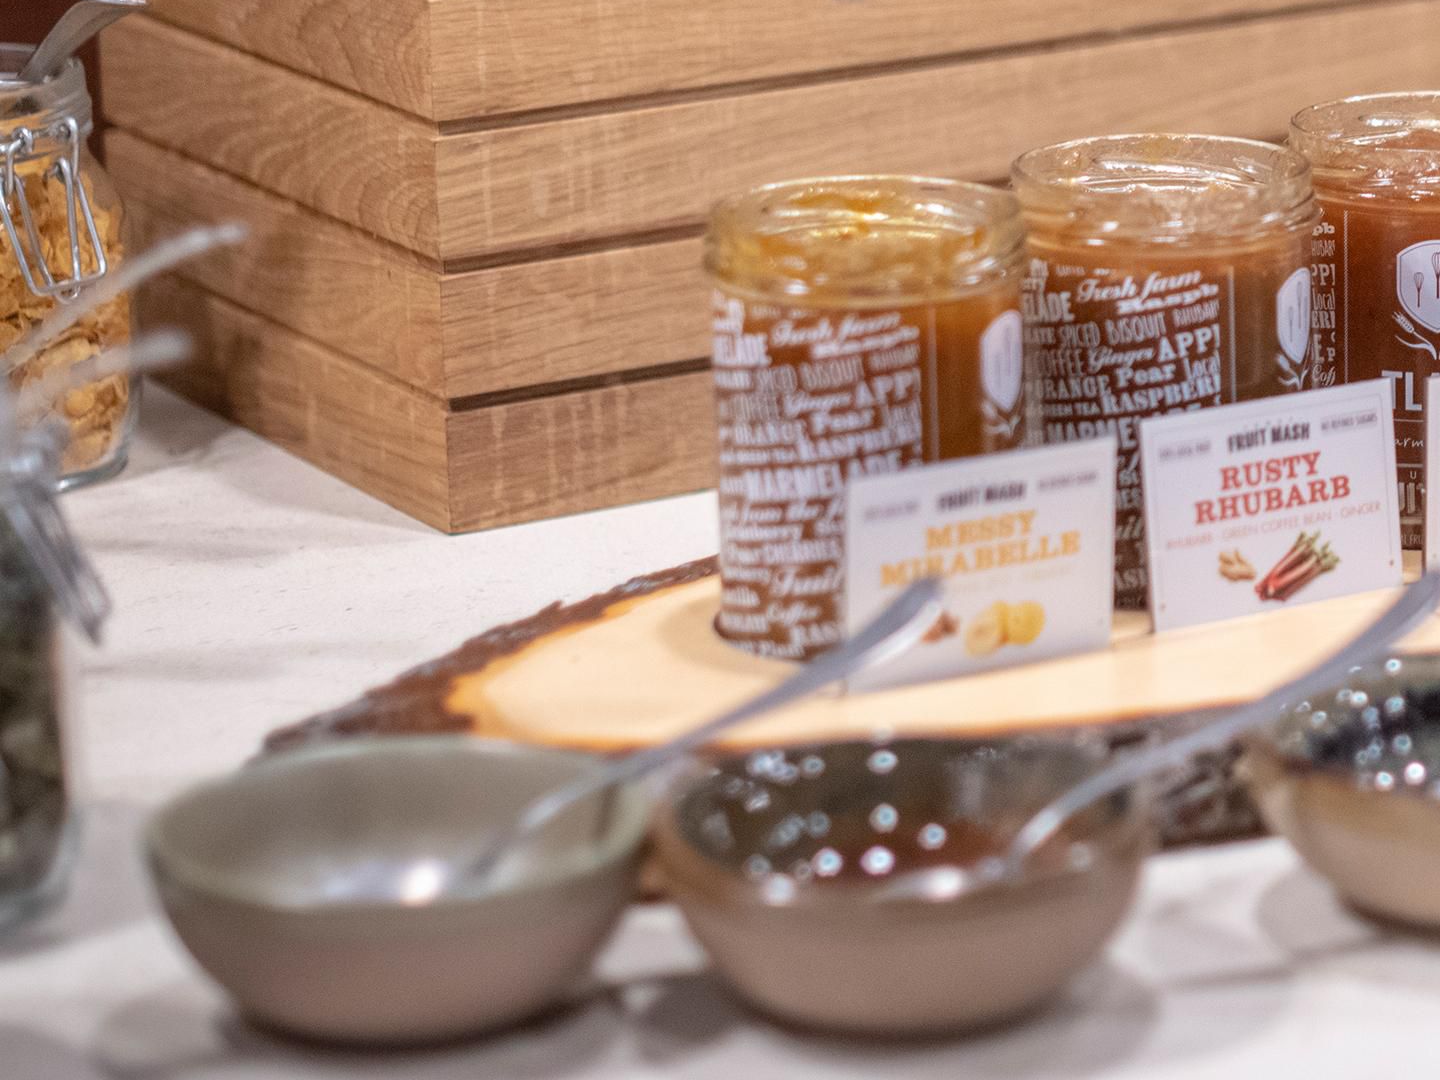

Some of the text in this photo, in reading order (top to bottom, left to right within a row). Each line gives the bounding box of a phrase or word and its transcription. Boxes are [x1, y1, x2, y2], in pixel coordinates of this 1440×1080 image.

[1105, 311, 1167, 345] BISQUIT
[1115, 363, 1176, 388] Pear
[1227, 428, 1268, 453] FRUIT
[1271, 422, 1311, 446] MASH
[1219, 450, 1321, 491] RUSTY
[1195, 474, 1351, 525] RHUBARB
[925, 510, 1036, 551] MESSY
